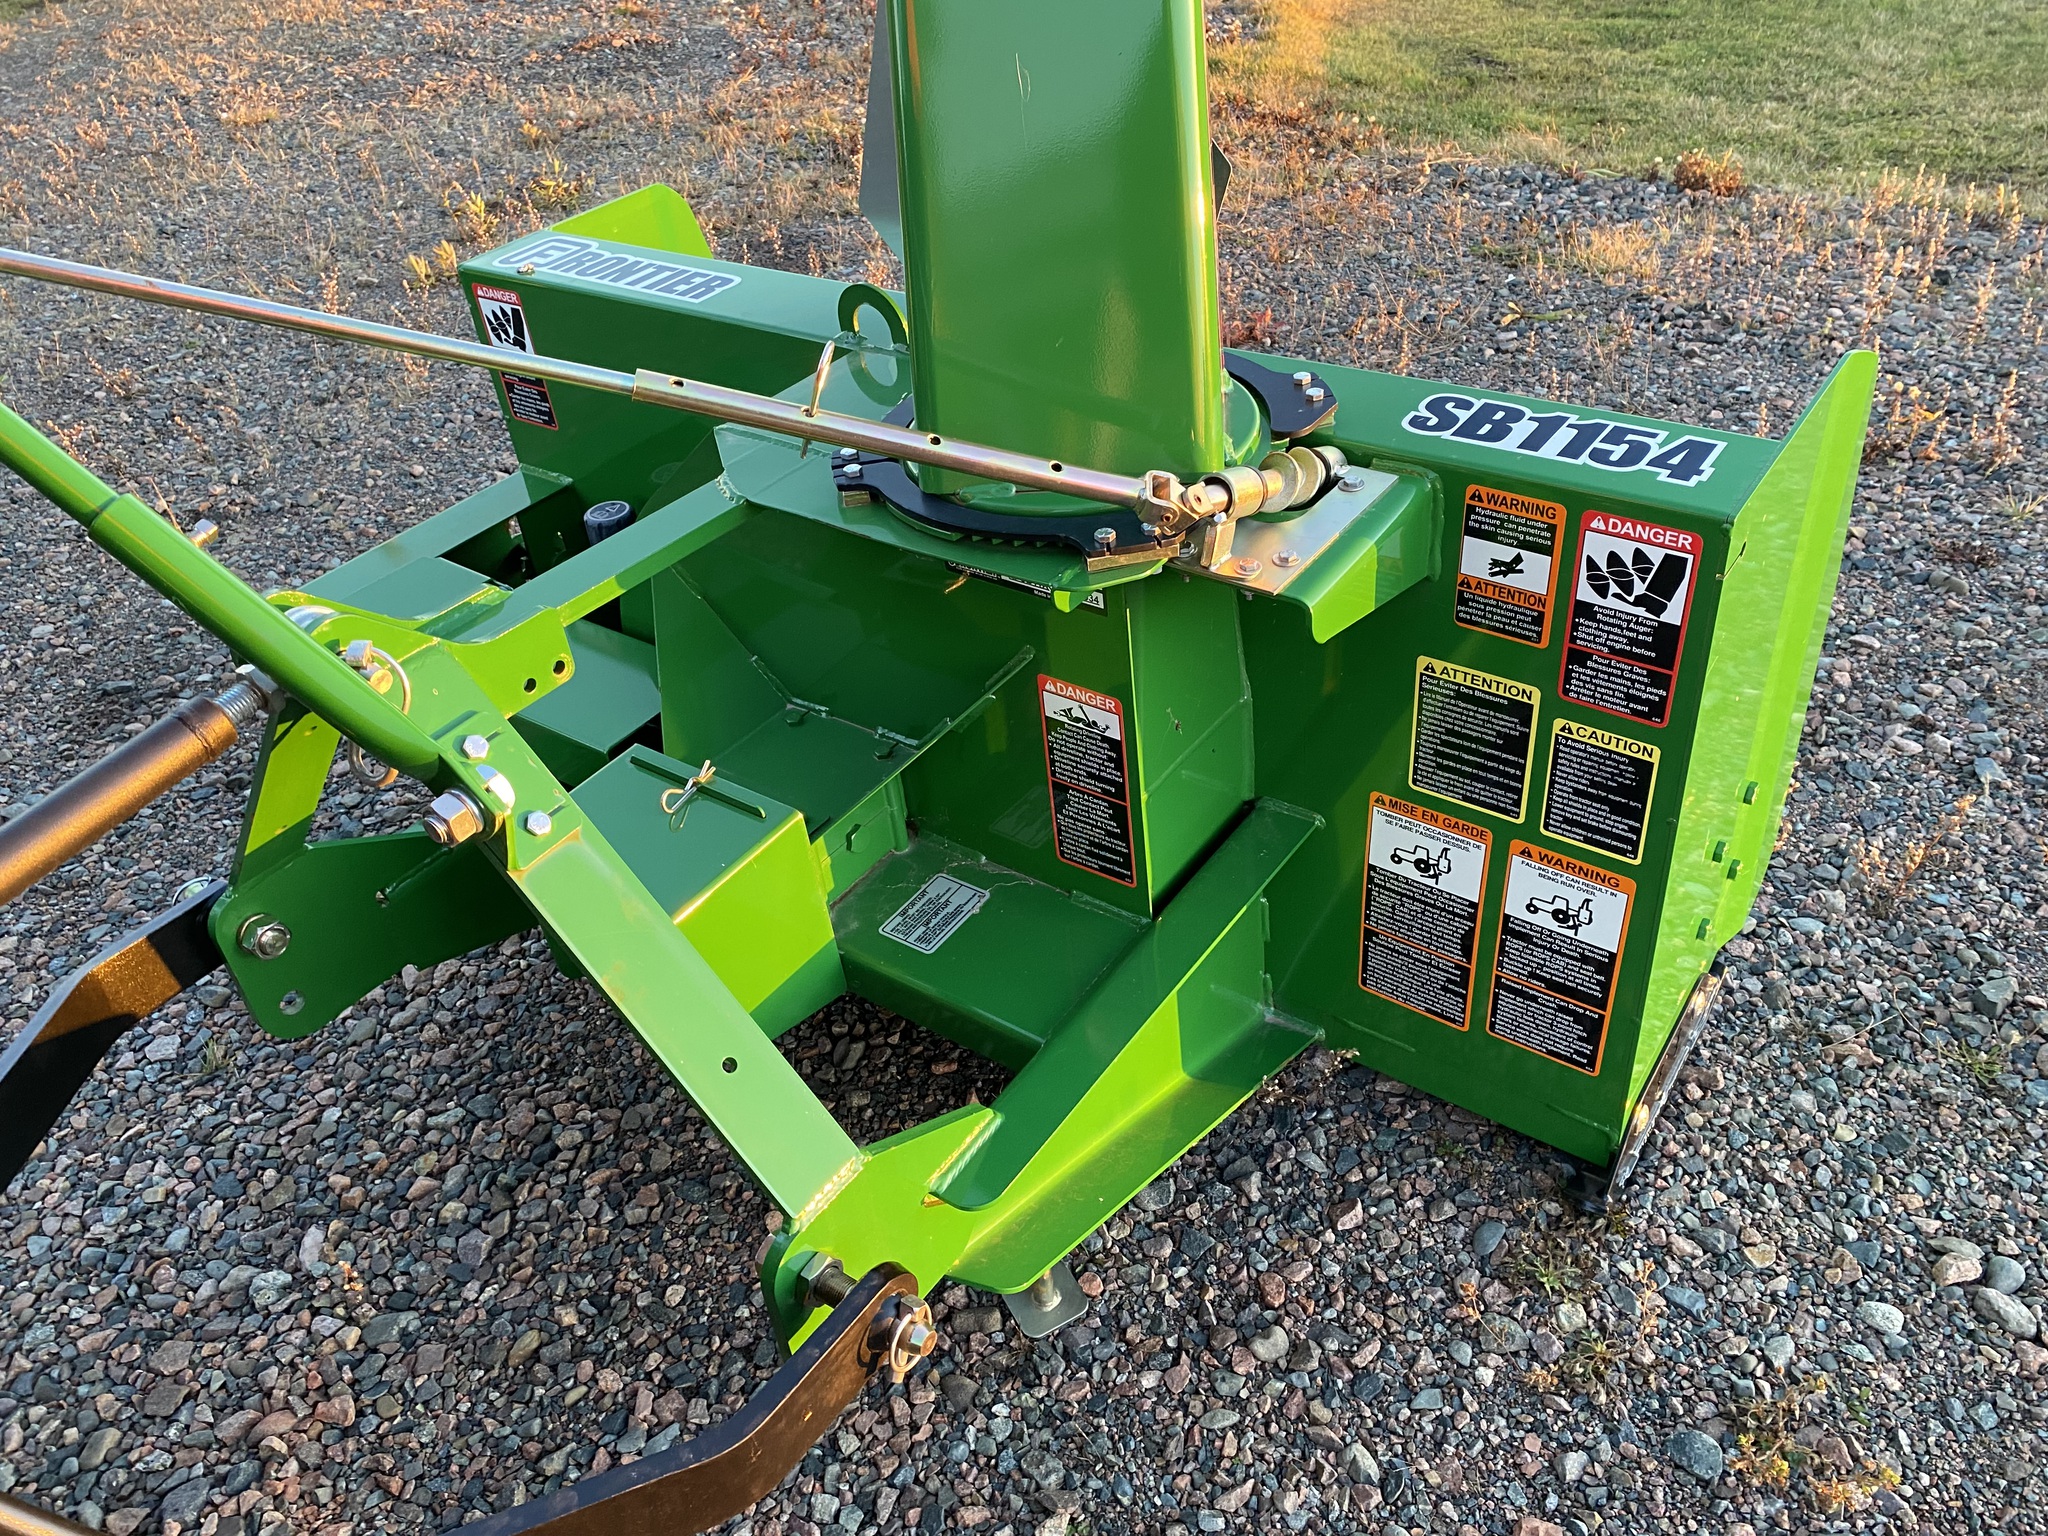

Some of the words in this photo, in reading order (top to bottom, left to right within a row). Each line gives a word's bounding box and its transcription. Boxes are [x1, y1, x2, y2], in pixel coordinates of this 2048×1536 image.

[498, 238, 735, 299] FRONTIER
[483, 287, 519, 303] DANGER
[1408, 396, 1719, 482] SB1154
[1476, 507, 1509, 520] Hydraulic
[1510, 515, 1526, 524] fluid
[1527, 521, 1548, 529] under
[1487, 493, 1557, 520] WARNING
[1471, 515, 1501, 526] pressure
[1518, 526, 1552, 538] penetrate
[1481, 524, 1496, 532] skin
[1497, 529, 1525, 540] causing
[1526, 536, 1552, 546] serious
[1608, 519, 1692, 550] DANGER
[1474, 581, 1547, 609] ATTENTION
[1475, 595, 1498, 606] liquide
[1499, 602, 1539, 617] hydraulique
[1472, 616, 1504, 629] blessures
[1486, 606, 1516, 617] pression
[1593, 606, 1615, 616] Avoid
[1616, 611, 1638, 622] Injury
[1639, 617, 1659, 627] From
[1493, 615, 1510, 623] peau
[1519, 622, 1542, 632] causer
[1579, 626, 1608, 639] clothing
[1609, 634, 1630, 644] away.
[1580, 618, 1599, 629] Keep
[1597, 614, 1628, 628] Rotating
[1629, 623, 1654, 634] Auger:
[1577, 632, 1594, 641] Shut
[1607, 641, 1632, 651] engine
[1632, 647, 1656, 658] before
[1577, 640, 1611, 653] servicing.
[1587, 661, 1622, 675] Blessures
[1623, 671, 1652, 684] Graves:
[1593, 655, 1610, 664] Pour
[1633, 667, 1647, 675] Des
[1440, 667, 1533, 701] ATTENTION
[1571, 679, 1584, 687] des
[1597, 687, 1614, 696] sans
[1615, 691, 1626, 699] fin.
[1573, 665, 1597, 676] Garder
[1598, 672, 1609, 680] les
[1635, 683, 1646, 691] les
[1647, 687, 1667, 697] pieds
[1580, 674, 1591, 682] les
[1057, 683, 1116, 712] DANGER
[1422, 676, 1439, 684] Pour
[1460, 686, 1474, 695] Des
[1475, 690, 1508, 705] Blessures
[1579, 695, 1595, 704] faire
[1596, 699, 1632, 714] l'entretien.
[1603, 695, 1628, 706] moteur
[1629, 703, 1649, 712] avant
[1558, 736, 1567, 744] To
[1567, 740, 1586, 750] Avoid
[1586, 745, 1610, 757] Serious
[1611, 754, 1629, 764] Injury
[1576, 727, 1654, 758] CAUTION
[1389, 799, 1419, 817] MISE
[1422, 810, 1439, 824] EN
[1443, 818, 1488, 841] GARDE
[1539, 852, 1620, 888] WARNING
[899, 889, 929, 918] IMPORTANT
[921, 899, 953, 928] IMPORTANT
